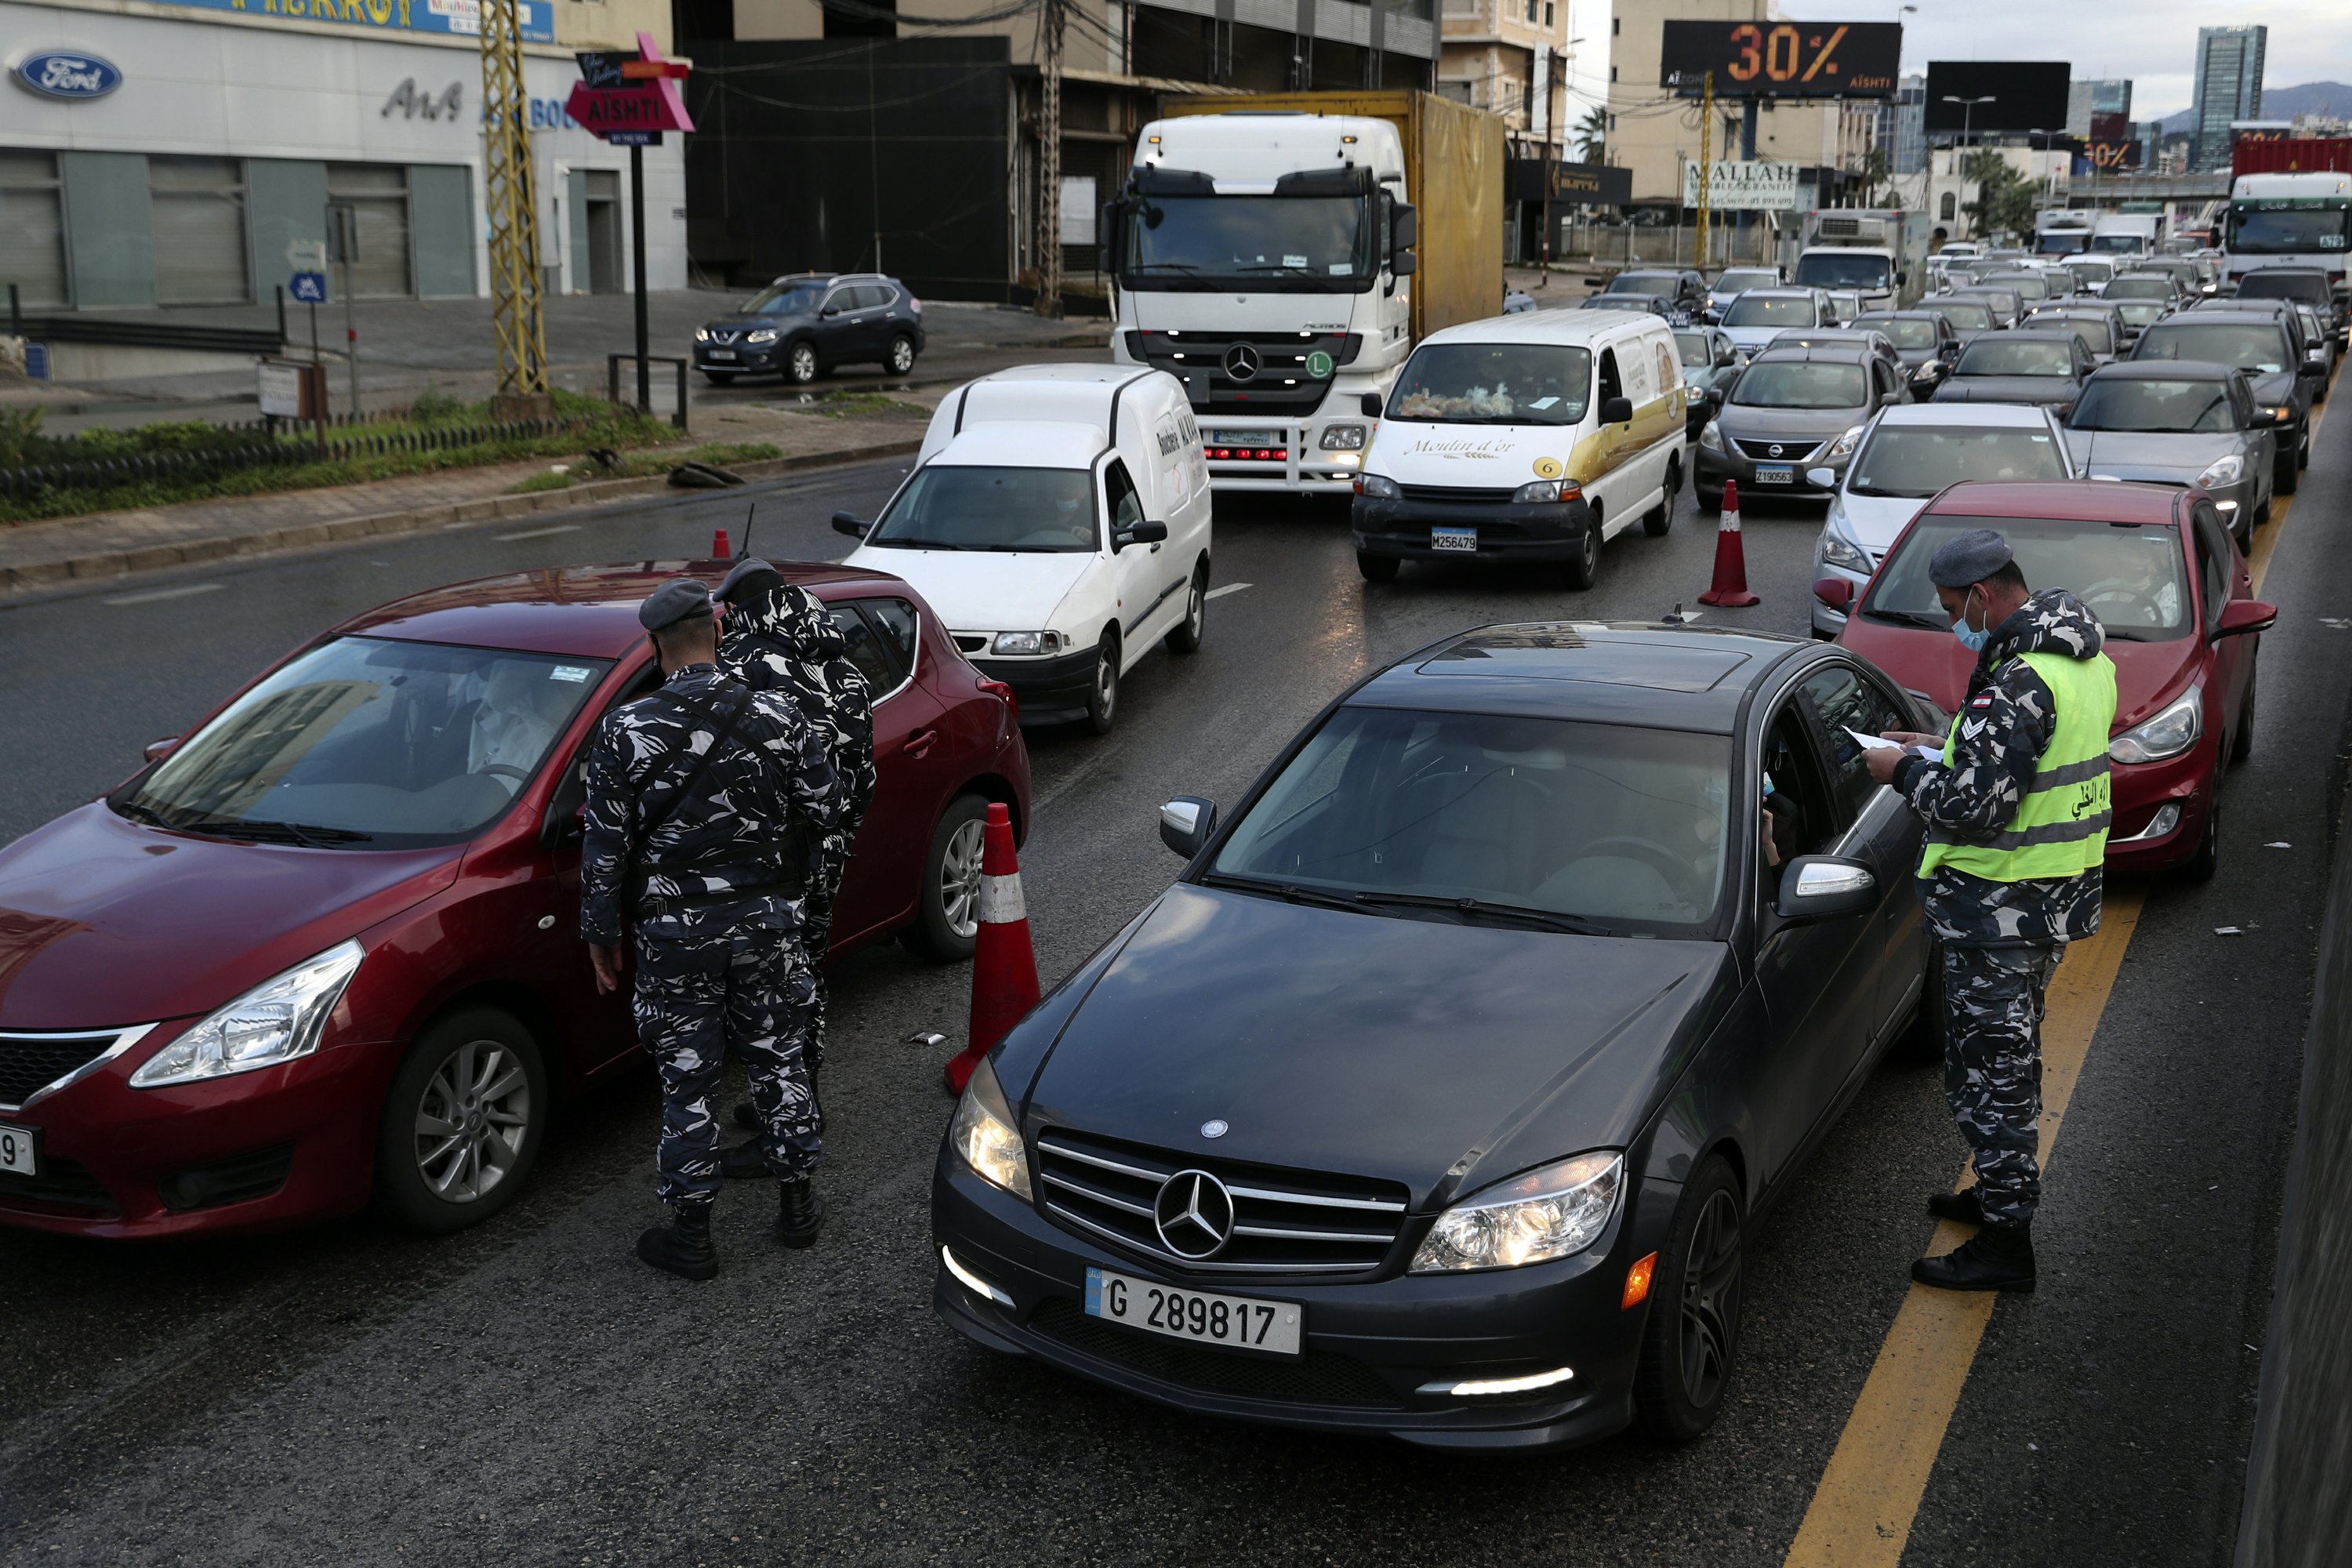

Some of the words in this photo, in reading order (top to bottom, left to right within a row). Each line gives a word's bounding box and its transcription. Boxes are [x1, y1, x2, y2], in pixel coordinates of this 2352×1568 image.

[1727, 24, 1849, 82] 30%
[41, 57, 102, 91] Ford
[589, 93, 660, 121] AÏSHTI
[1690, 165, 1792, 181] MALLAH
[1314, 356, 1323, 372] L
[1403, 439, 1474, 456] Moulin
[1542, 463, 1553, 474] 6
[1756, 472, 1791, 482] Z190563
[1432, 536, 1475, 549] M256479
[2, 1134, 16, 1166] 9
[1109, 1279, 1127, 1316] G
[1147, 1288, 1276, 1345] 289817
